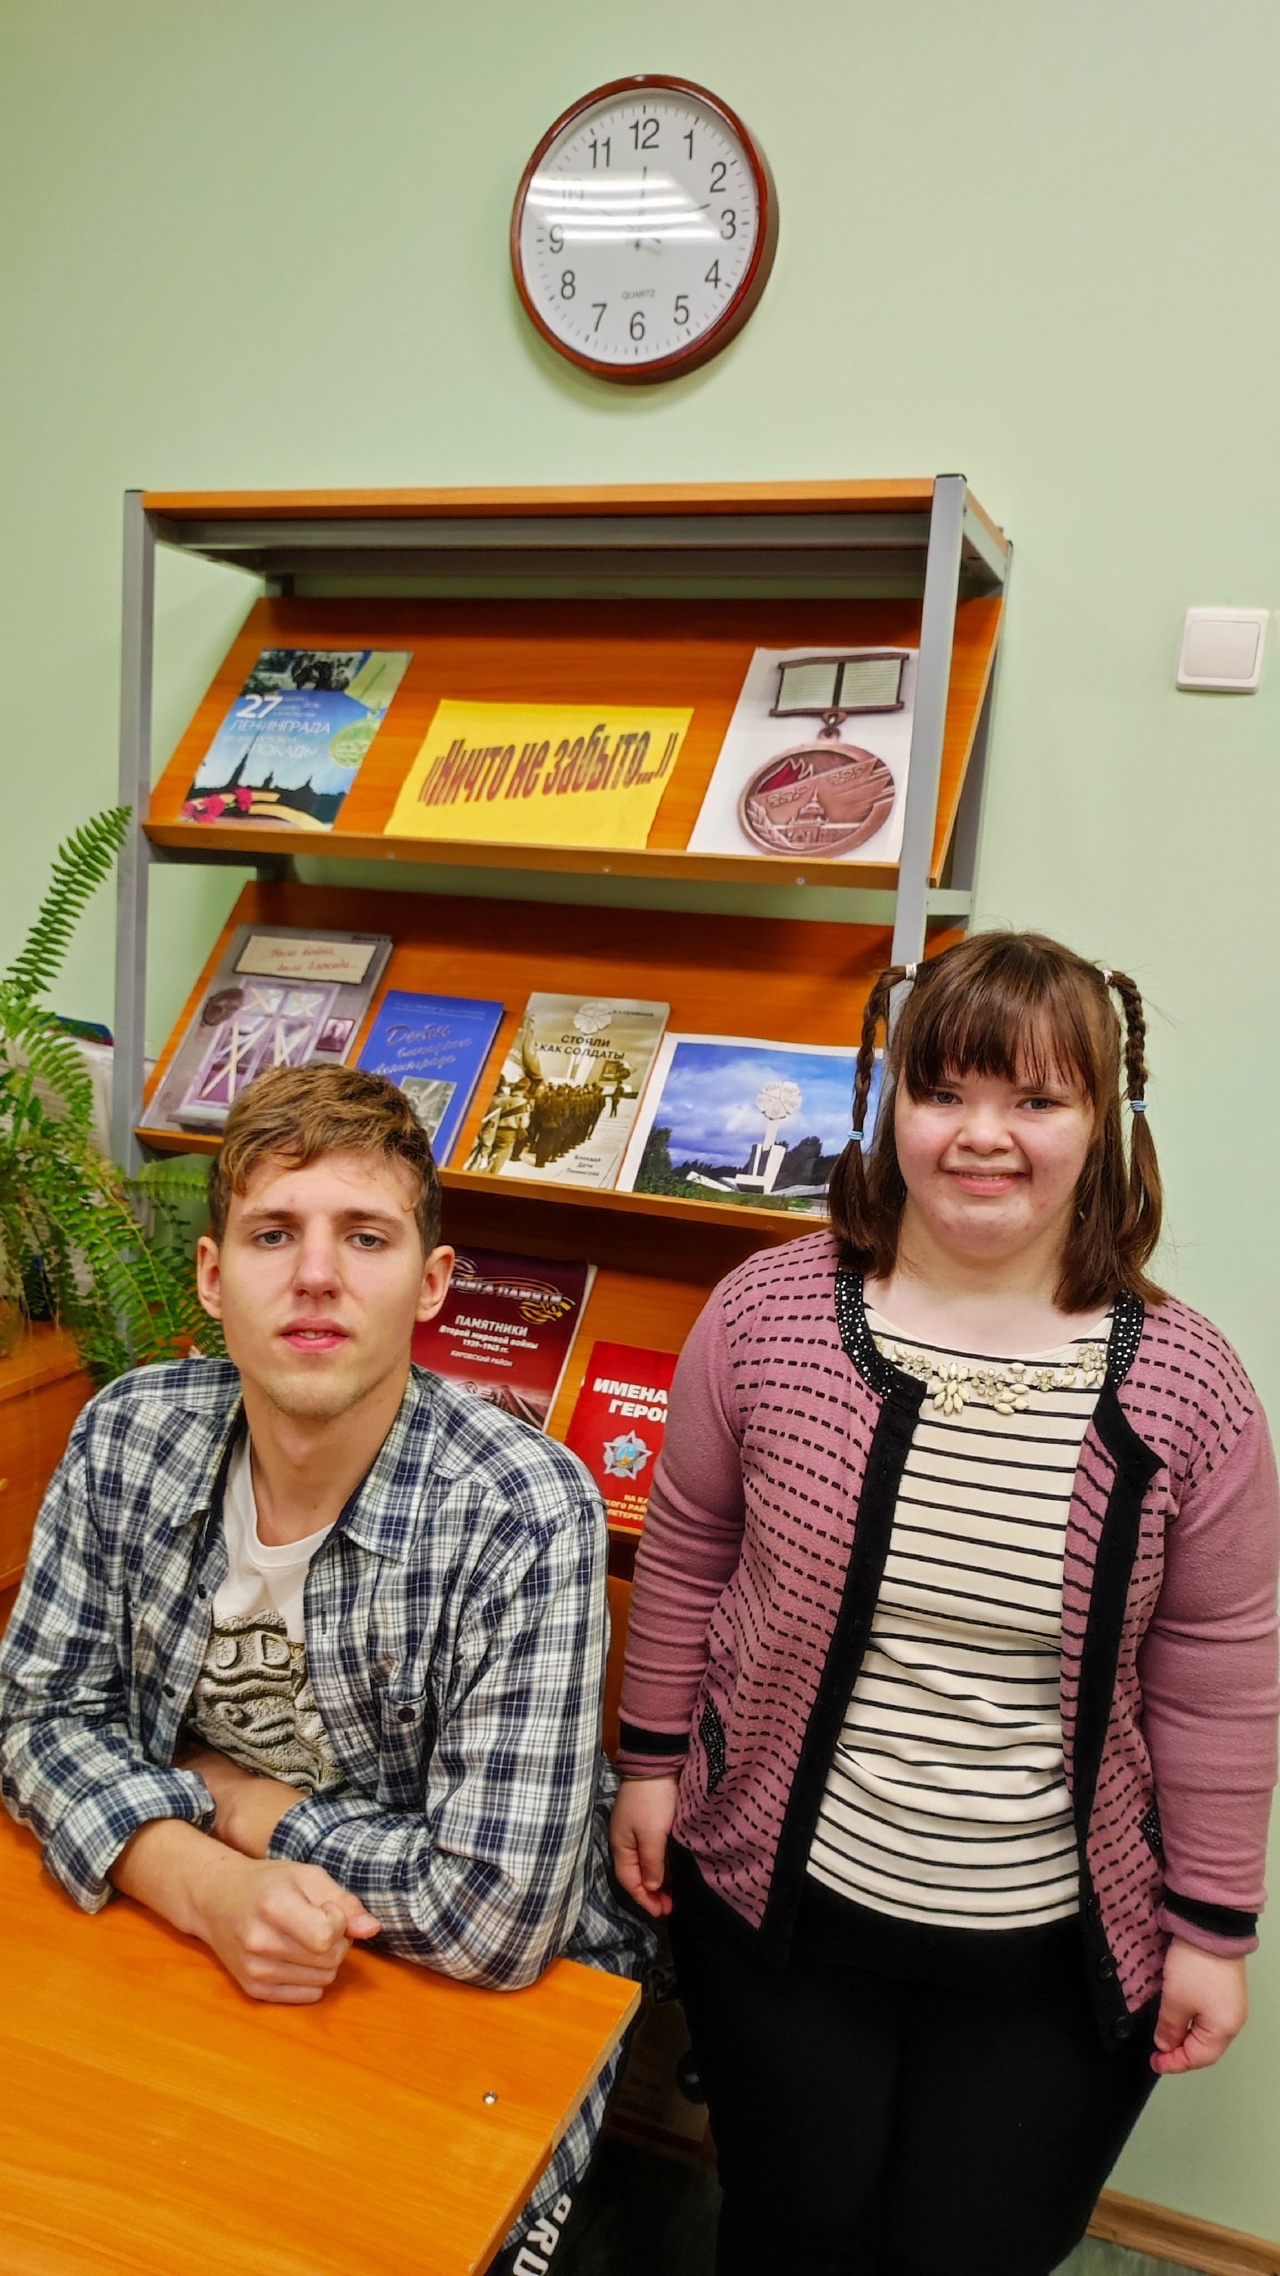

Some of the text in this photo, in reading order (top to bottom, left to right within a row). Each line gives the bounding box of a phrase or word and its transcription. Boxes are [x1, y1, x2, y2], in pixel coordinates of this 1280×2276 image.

[629, 118, 660, 150] 12
[683, 129, 694, 160] 1
[588, 137, 611, 169] 11
[709, 161, 726, 192] 2
[549, 223, 565, 253] 9
[720, 209, 736, 240] 3
[560, 270, 576, 300] 8
[704, 259, 721, 289] 4
[621, 289, 656, 300] QUARTZ
[591, 303, 607, 332] 7
[673, 295, 690, 325] 5
[629, 312, 646, 341] 6
[236, 693, 284, 719] 27
[229, 719, 331, 735] ЛЕНИНГРАДА
[504, 740, 550, 799] не
[539, 1042, 626, 1060] КАК СОЛДАТЫ
[561, 1034, 611, 1048] СТОЯЛИ
[438, 1324, 539, 1350] Второй мировой войны
[454, 1314, 529, 1337] ПАМЯТНИКИ
[593, 1377, 668, 1404] ИМЕНА
[624, 1494, 636, 1502] НА
